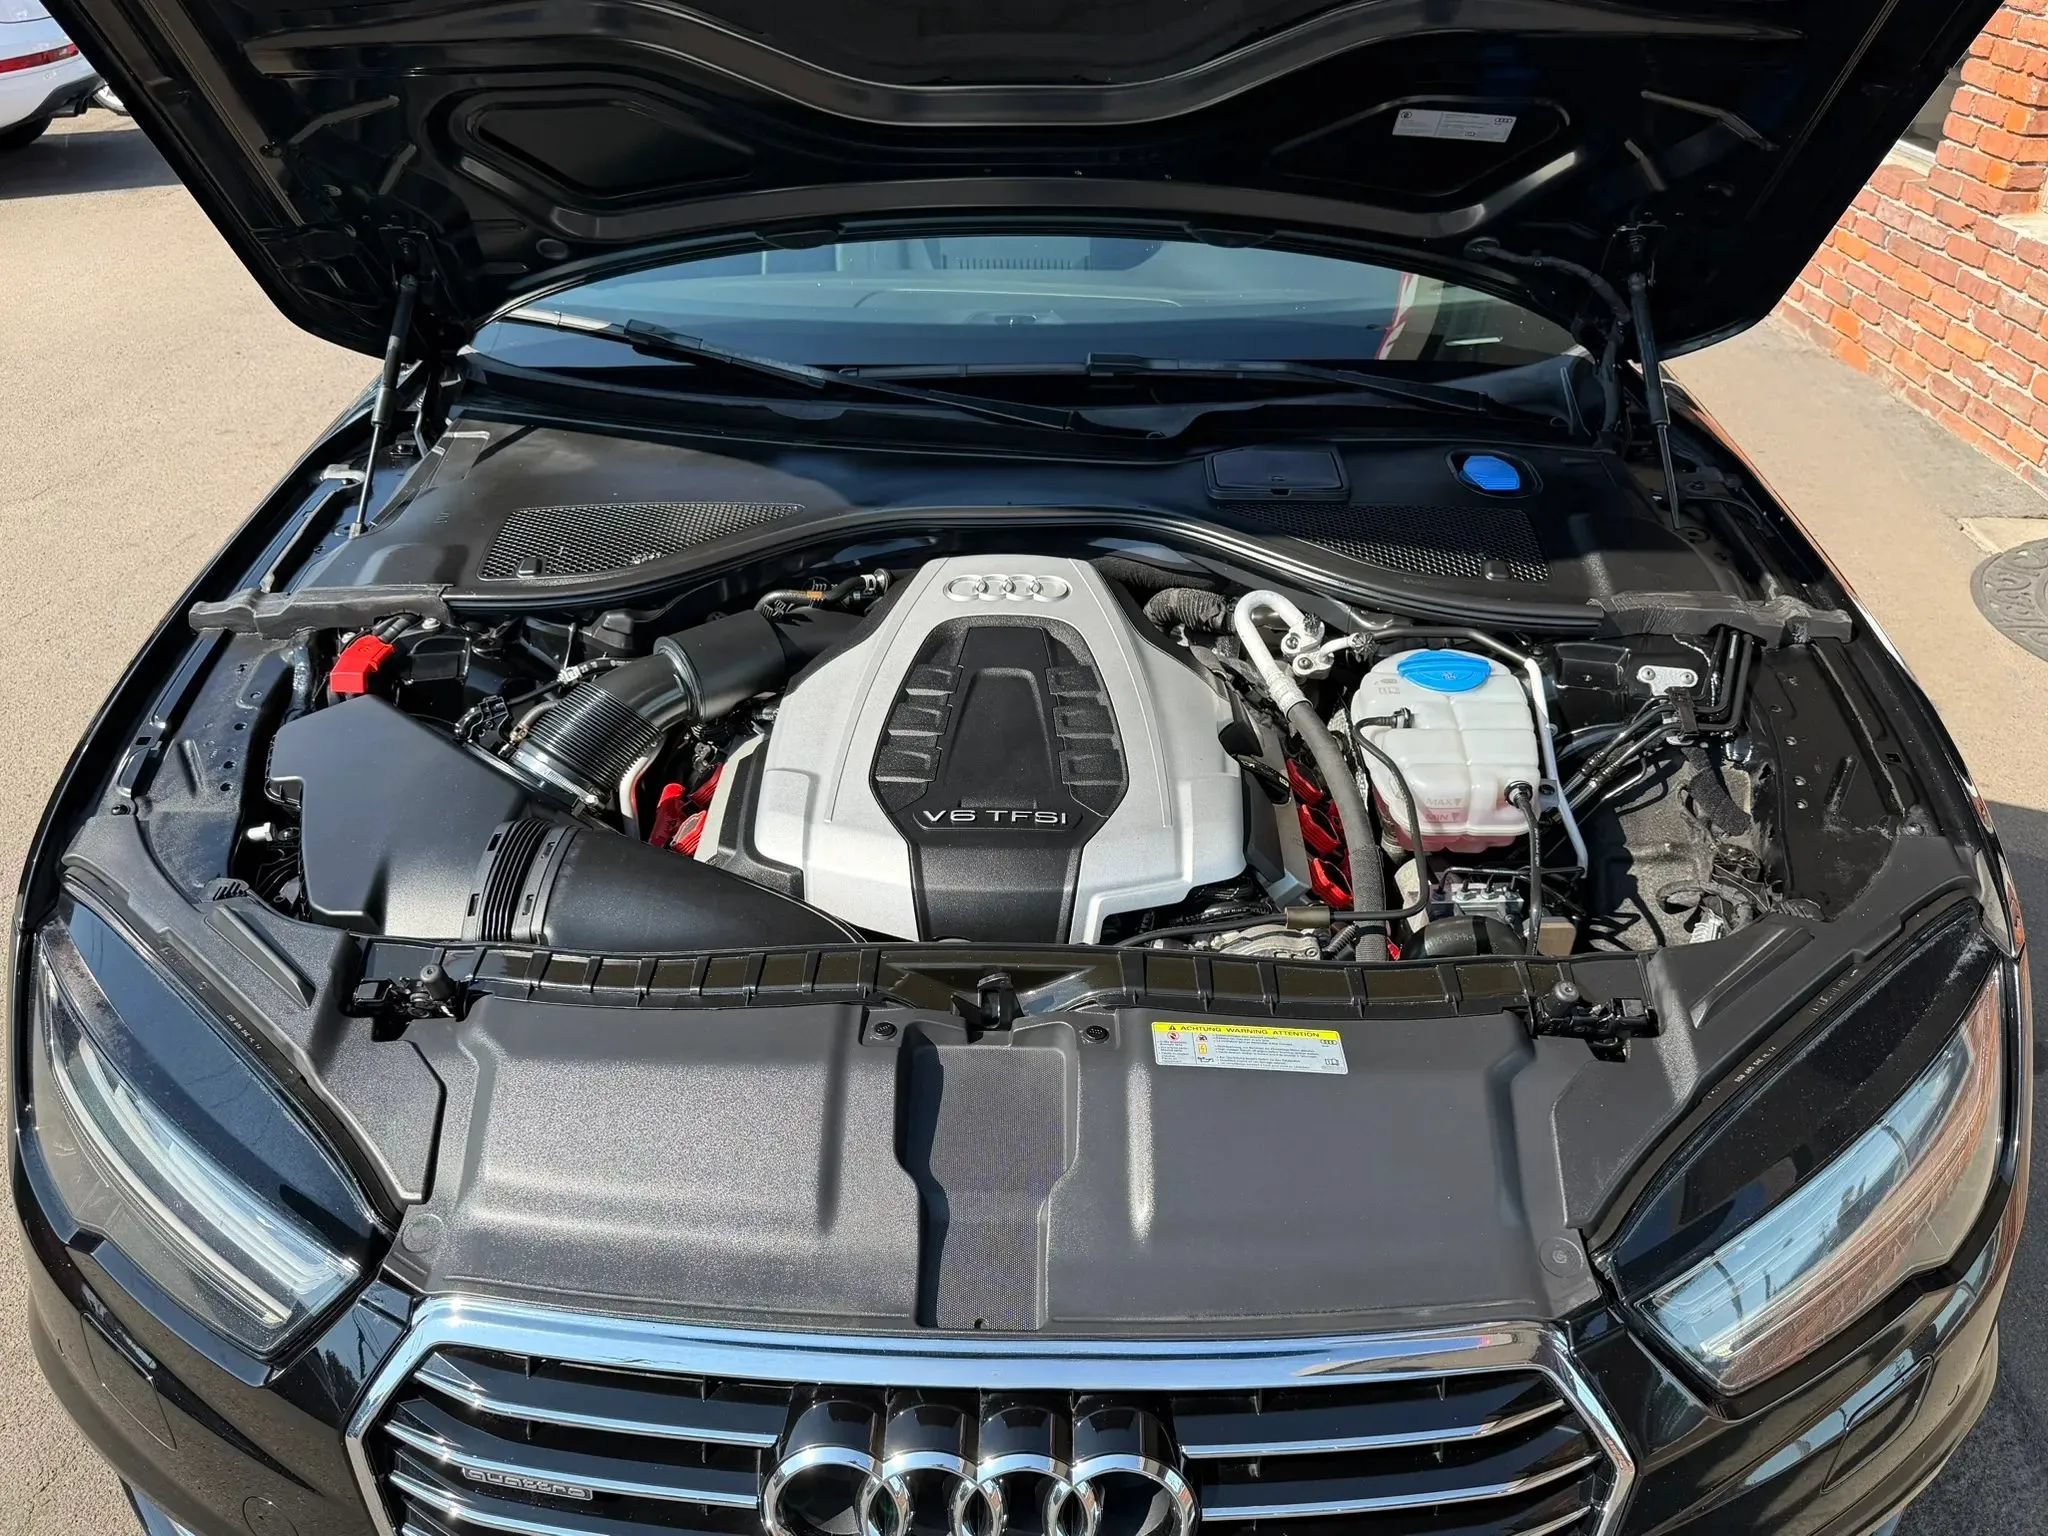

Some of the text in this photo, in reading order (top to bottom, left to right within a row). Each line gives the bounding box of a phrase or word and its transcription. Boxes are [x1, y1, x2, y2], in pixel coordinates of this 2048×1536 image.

[923, 809, 1066, 825] V6 TFSI
[1180, 1025, 1320, 1038] ACHTUNG WARNING ATTENTION
[468, 1469, 586, 1498] quattro
